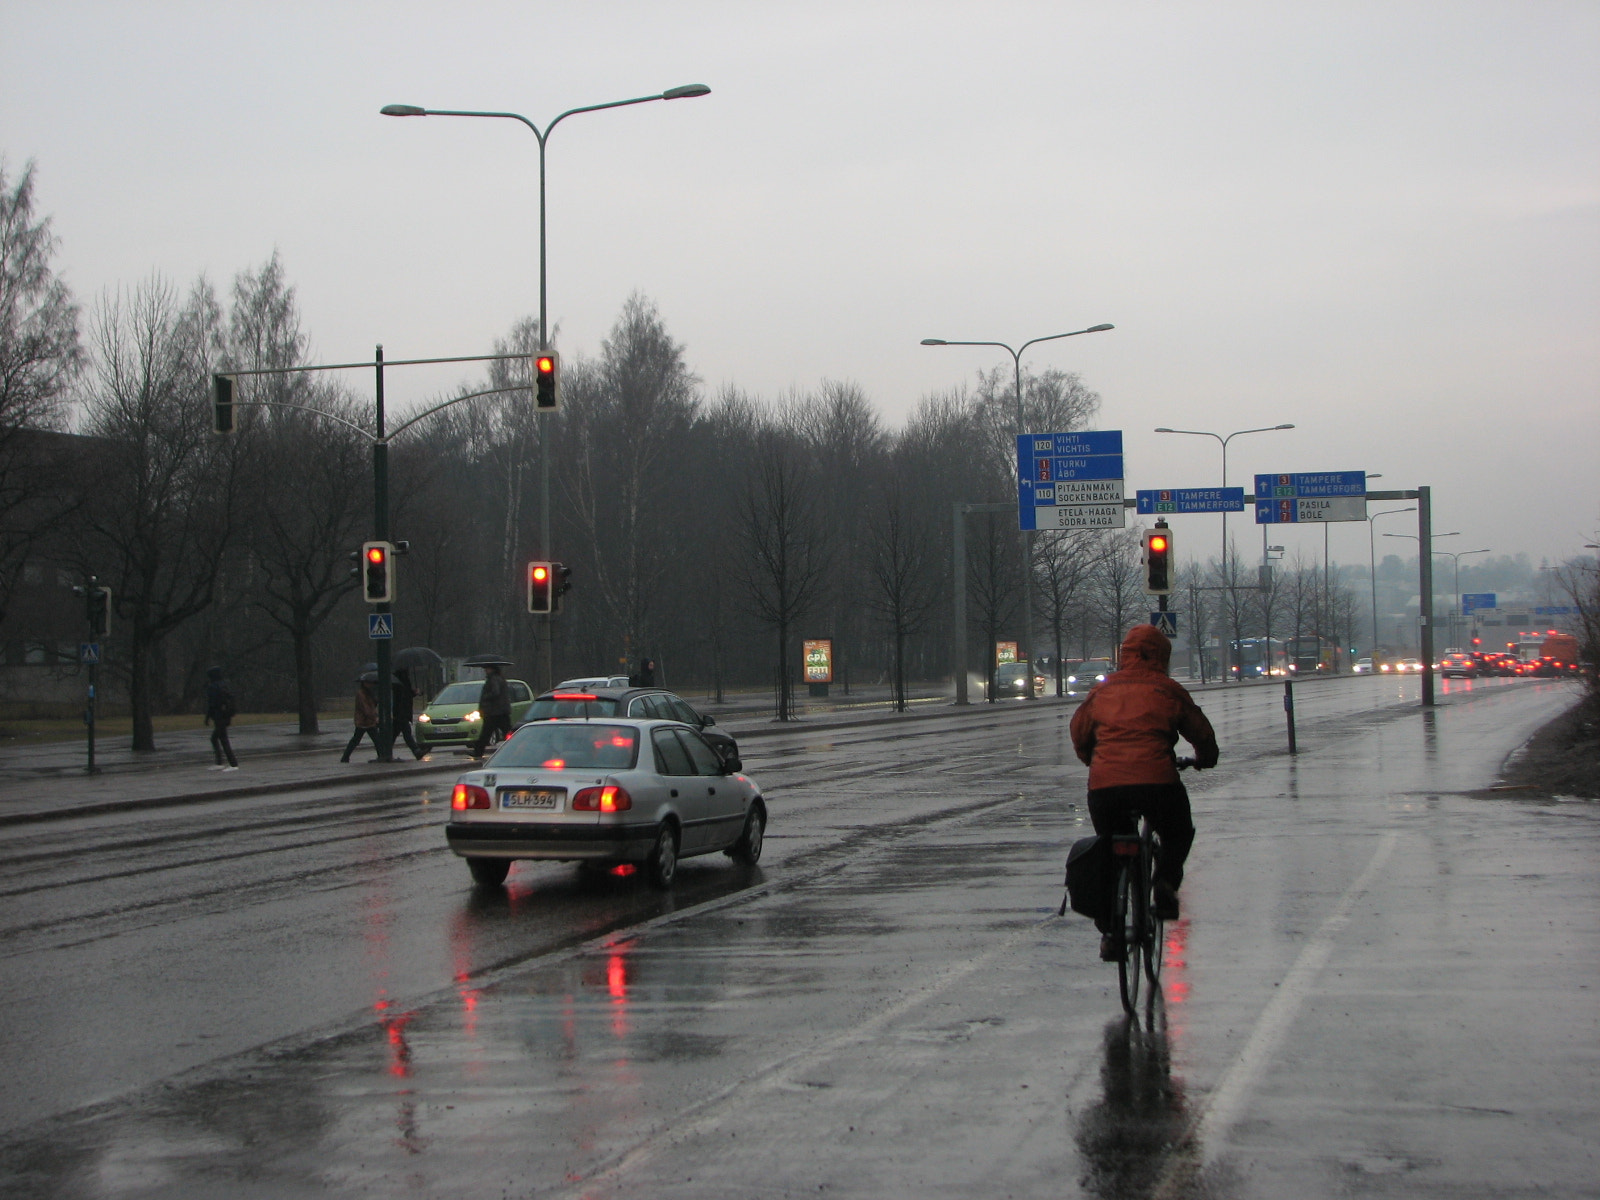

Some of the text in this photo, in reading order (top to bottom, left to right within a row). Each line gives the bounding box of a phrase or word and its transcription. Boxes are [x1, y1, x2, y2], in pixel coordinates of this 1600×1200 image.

[1056, 436, 1079, 444] VIHTI
[1036, 442, 1050, 450] 120
[1056, 444, 1090, 453] VICHTIS
[1058, 460, 1086, 468] TURKU
[1300, 475, 1342, 484] TAMPERE
[1300, 484, 1363, 494] TAMMERFORS
[1180, 491, 1222, 500] TAMPERE
[1180, 500, 1240, 510] TAMMERFORS
[1300, 501, 1330, 509] PASILA
[1090, 517, 1113, 525] HAGA
